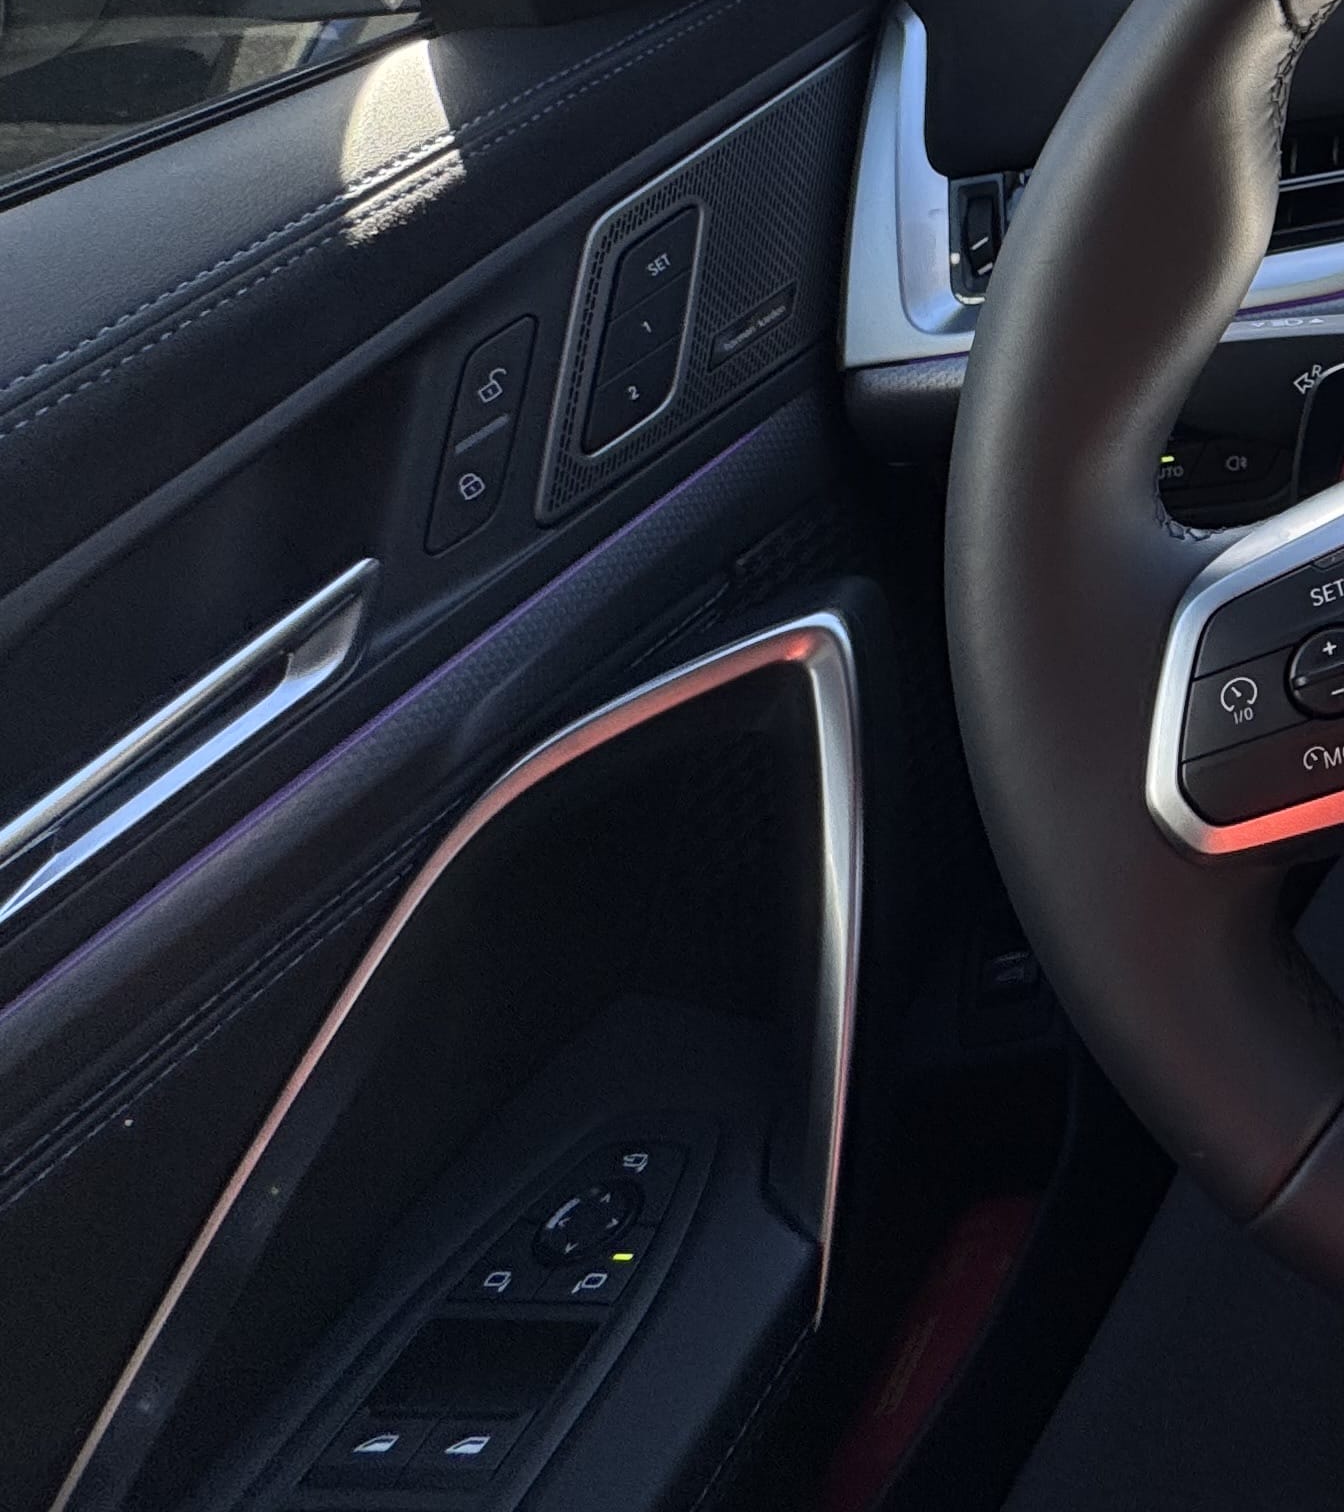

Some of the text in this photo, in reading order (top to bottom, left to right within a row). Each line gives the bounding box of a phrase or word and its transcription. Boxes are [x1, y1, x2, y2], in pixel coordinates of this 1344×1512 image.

[647, 253, 672, 277] SET
[642, 320, 651, 333] 1
[628, 385, 639, 400] 2
[1310, 579, 1344, 607] SET
